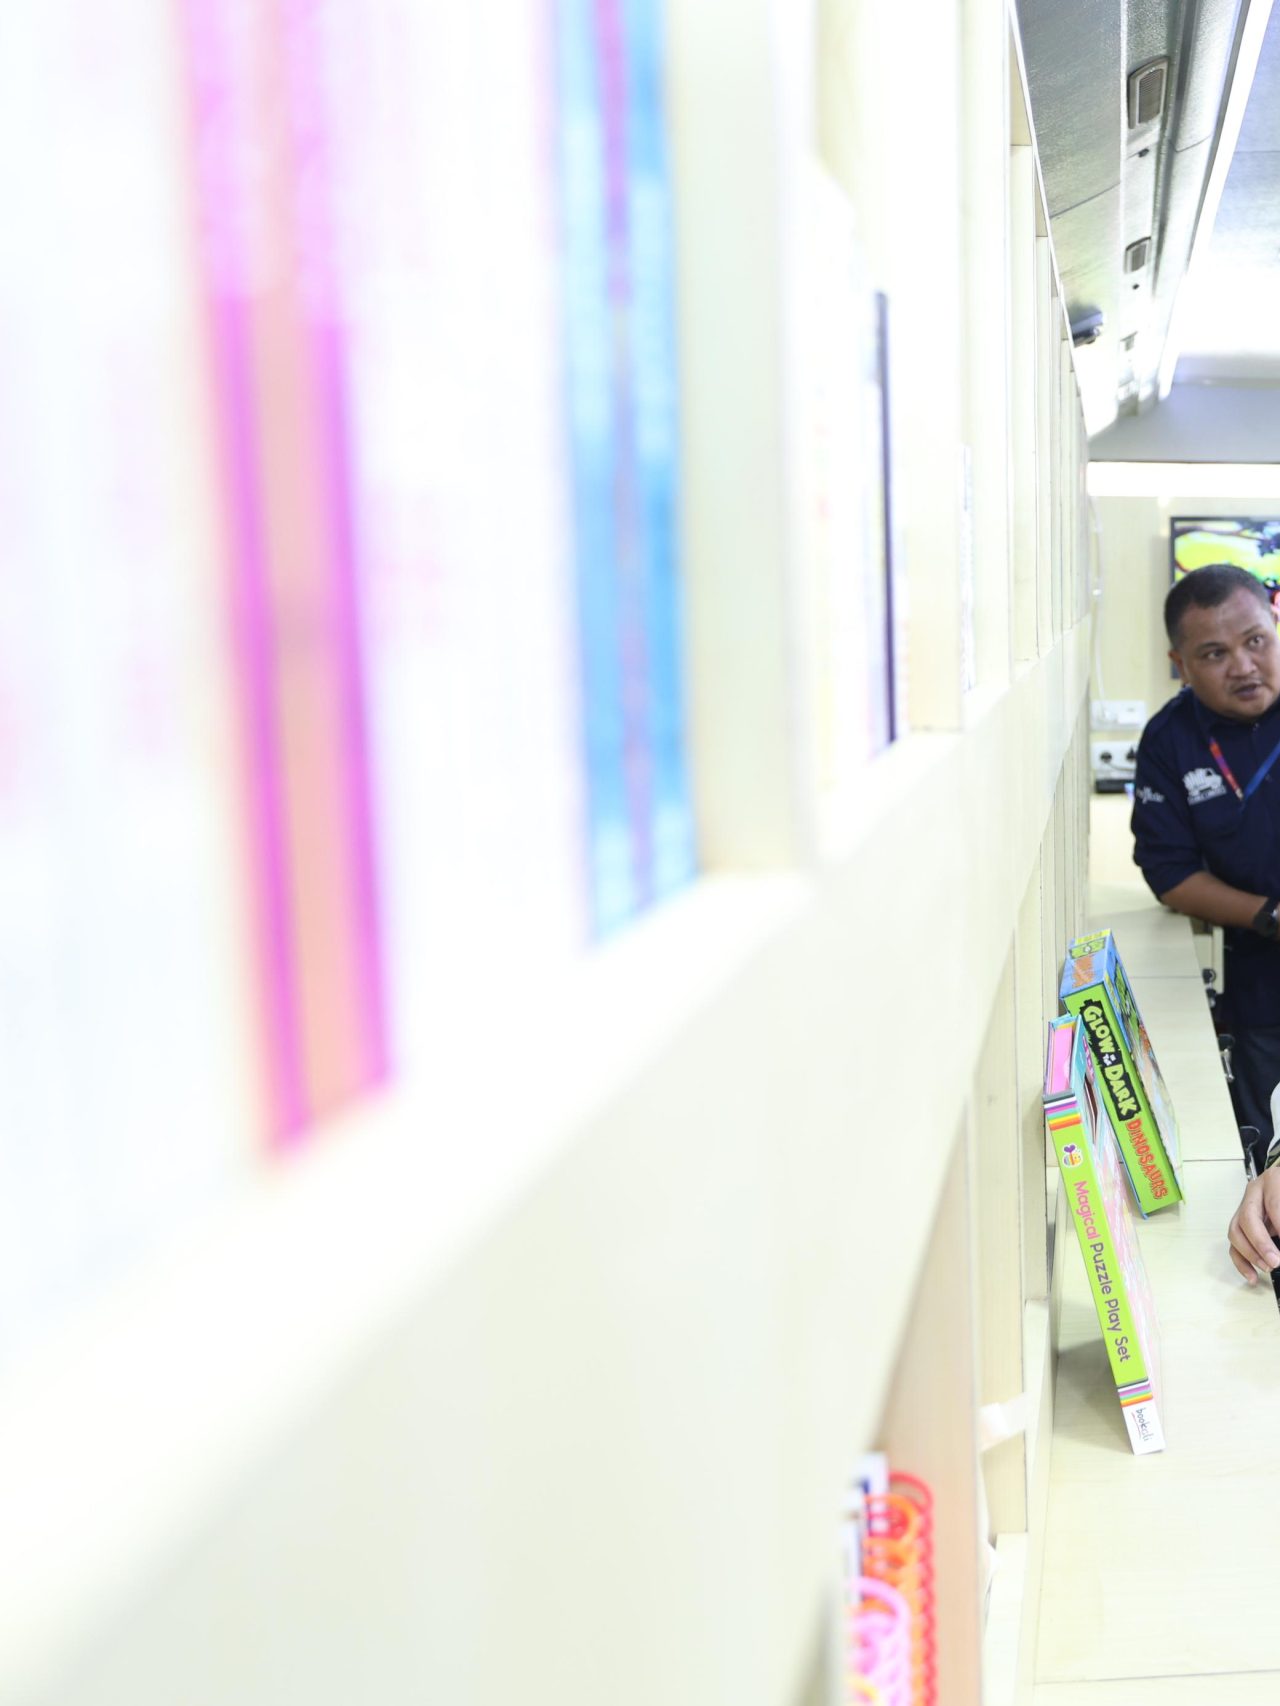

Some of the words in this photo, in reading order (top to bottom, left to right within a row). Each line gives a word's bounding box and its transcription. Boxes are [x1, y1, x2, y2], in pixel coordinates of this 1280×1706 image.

[1083, 1005, 1116, 1053] GLOW
[1104, 1063, 1138, 1116] DARK
[1125, 1118, 1168, 1200] DINOSAURS
[1074, 1181, 1101, 1240] Magical
[1090, 1242, 1112, 1295] Puzzle
[1105, 1298, 1122, 1332] Play
[1115, 1336, 1131, 1363] Set
